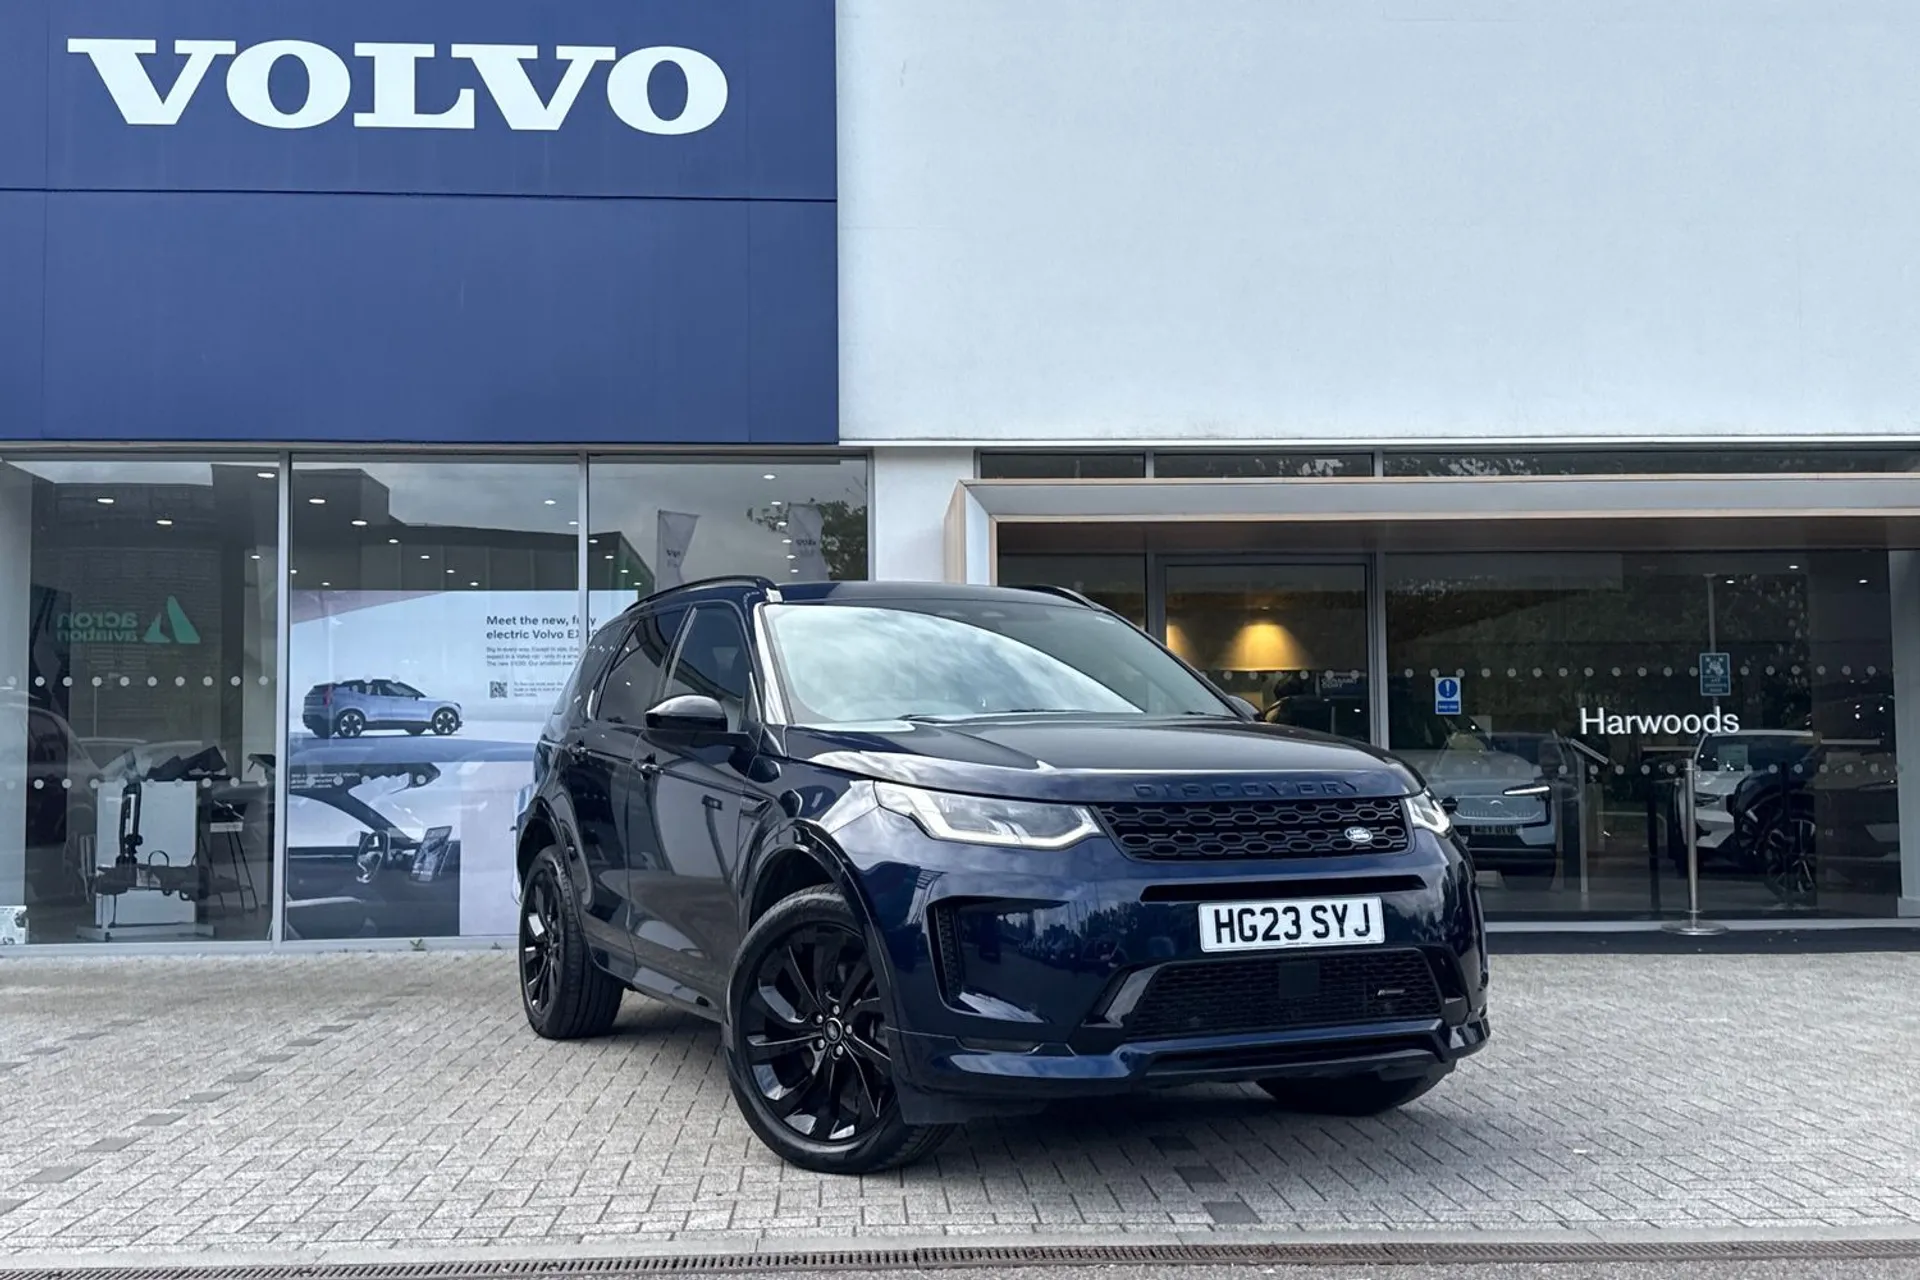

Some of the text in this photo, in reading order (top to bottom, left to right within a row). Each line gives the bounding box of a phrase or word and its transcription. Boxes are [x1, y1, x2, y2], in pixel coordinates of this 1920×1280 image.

[67, 38, 728, 135] VOLVO
[486, 615, 516, 625] Meet
[520, 615, 539, 625] the
[542, 617, 569, 626] new,
[486, 629, 530, 639] electric
[532, 629, 564, 639] Volvo
[1580, 705, 1740, 735] Harwoods
[1132, 781, 1361, 798] DISCOVERY
[1213, 903, 1371, 944] HG23 SYJ
